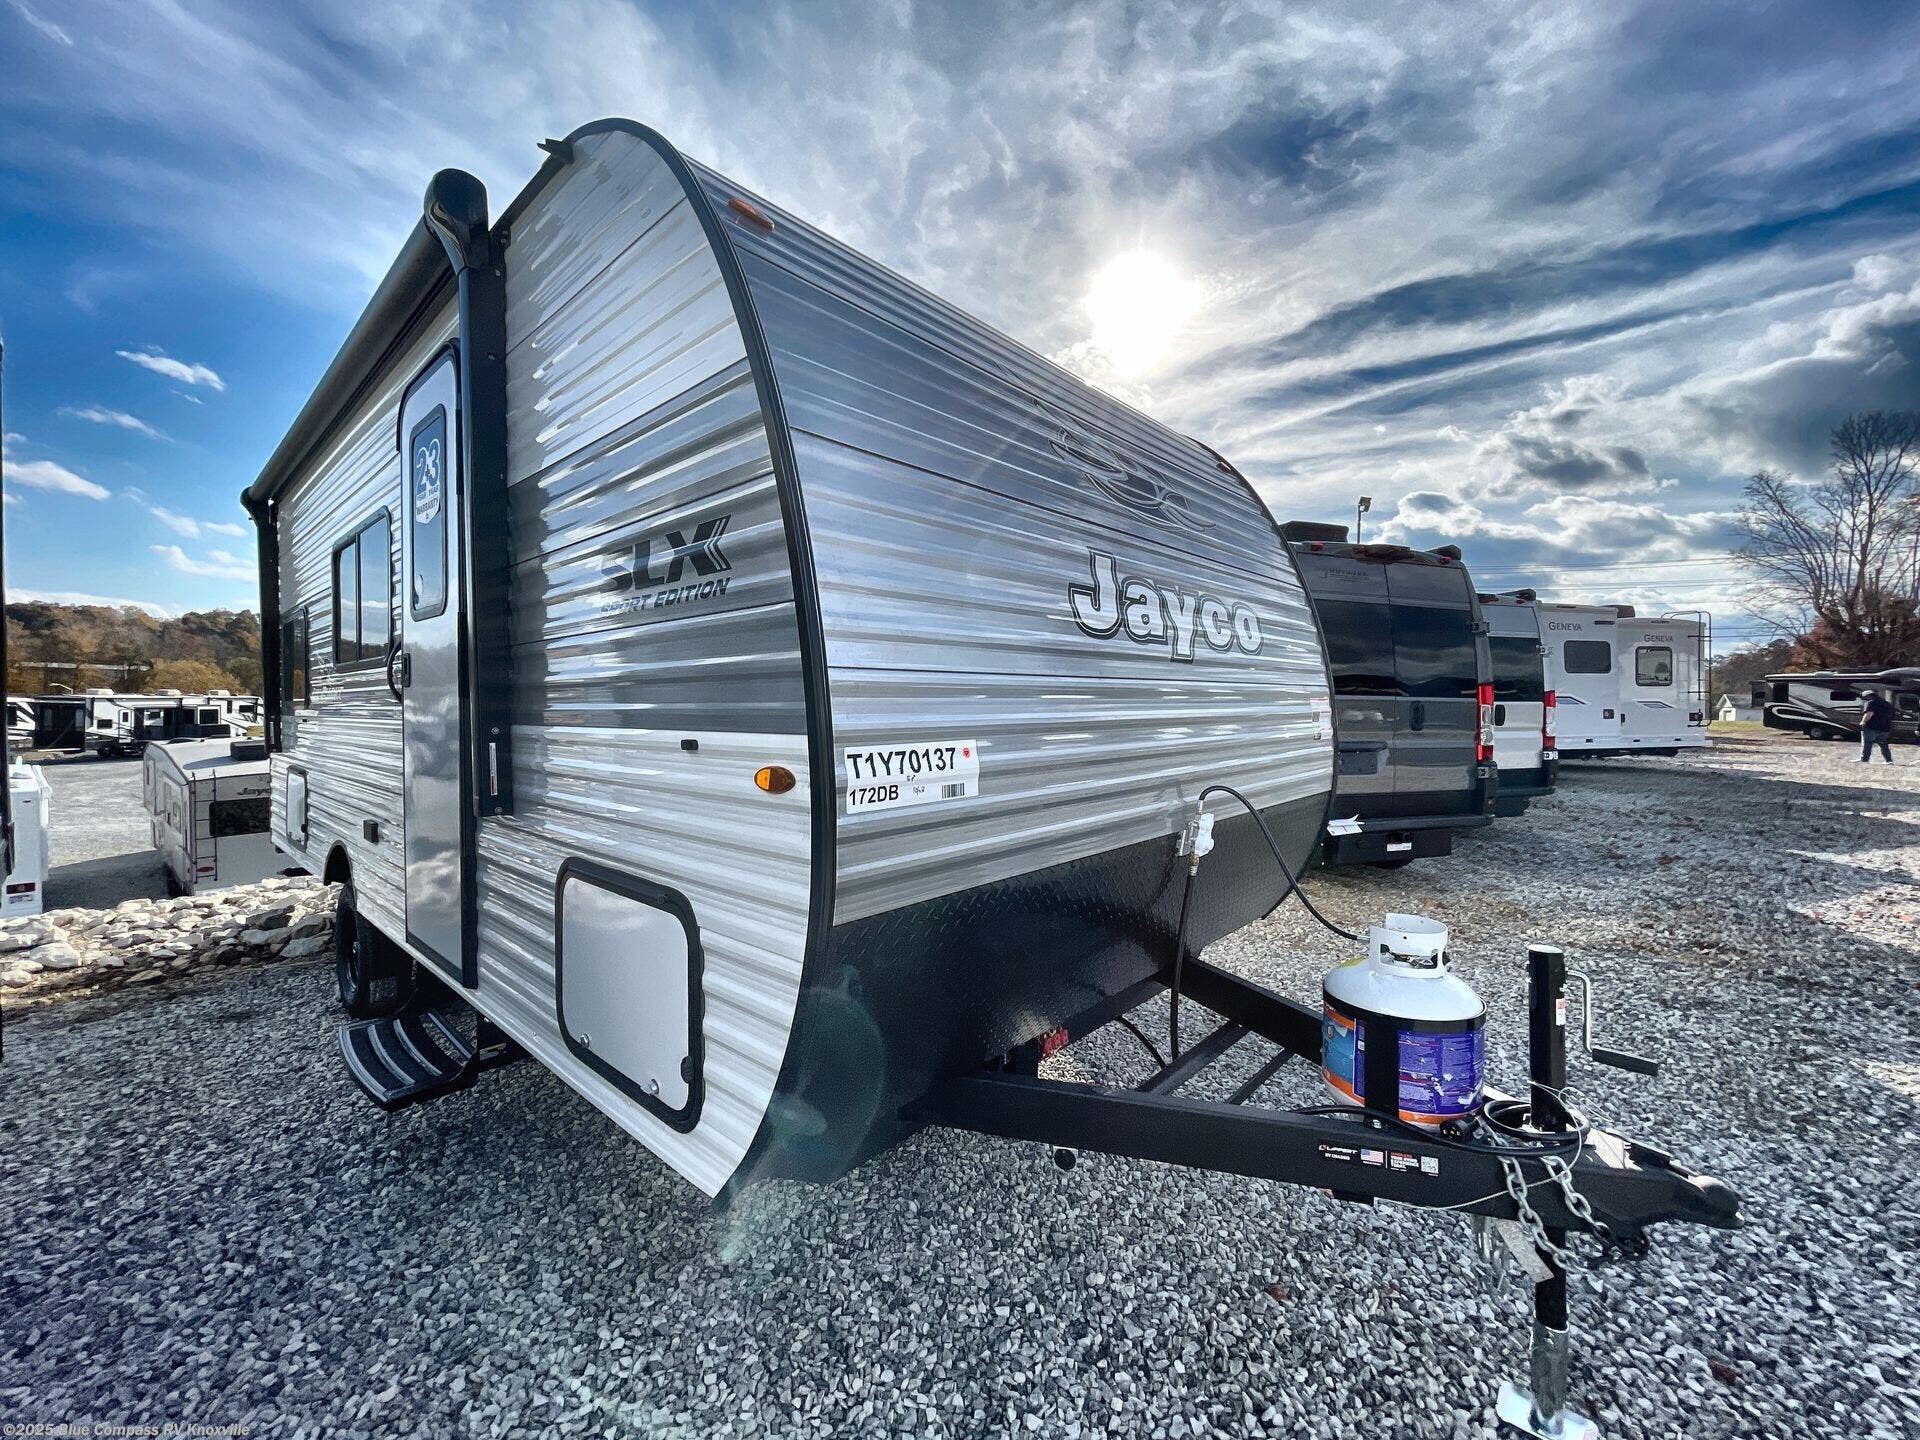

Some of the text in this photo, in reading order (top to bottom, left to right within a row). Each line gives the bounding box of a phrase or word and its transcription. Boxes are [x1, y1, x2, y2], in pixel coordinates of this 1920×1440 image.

[416, 496, 439, 515] WARRANTY
[601, 514, 732, 594] SLX
[654, 576, 731, 608] EDITION
[1067, 546, 1265, 663] Jayco
[1548, 621, 1582, 631] GENEVA
[1643, 634, 1674, 643] GENEVA
[847, 747, 956, 779] T1Y70137
[849, 784, 899, 806] 172DB
